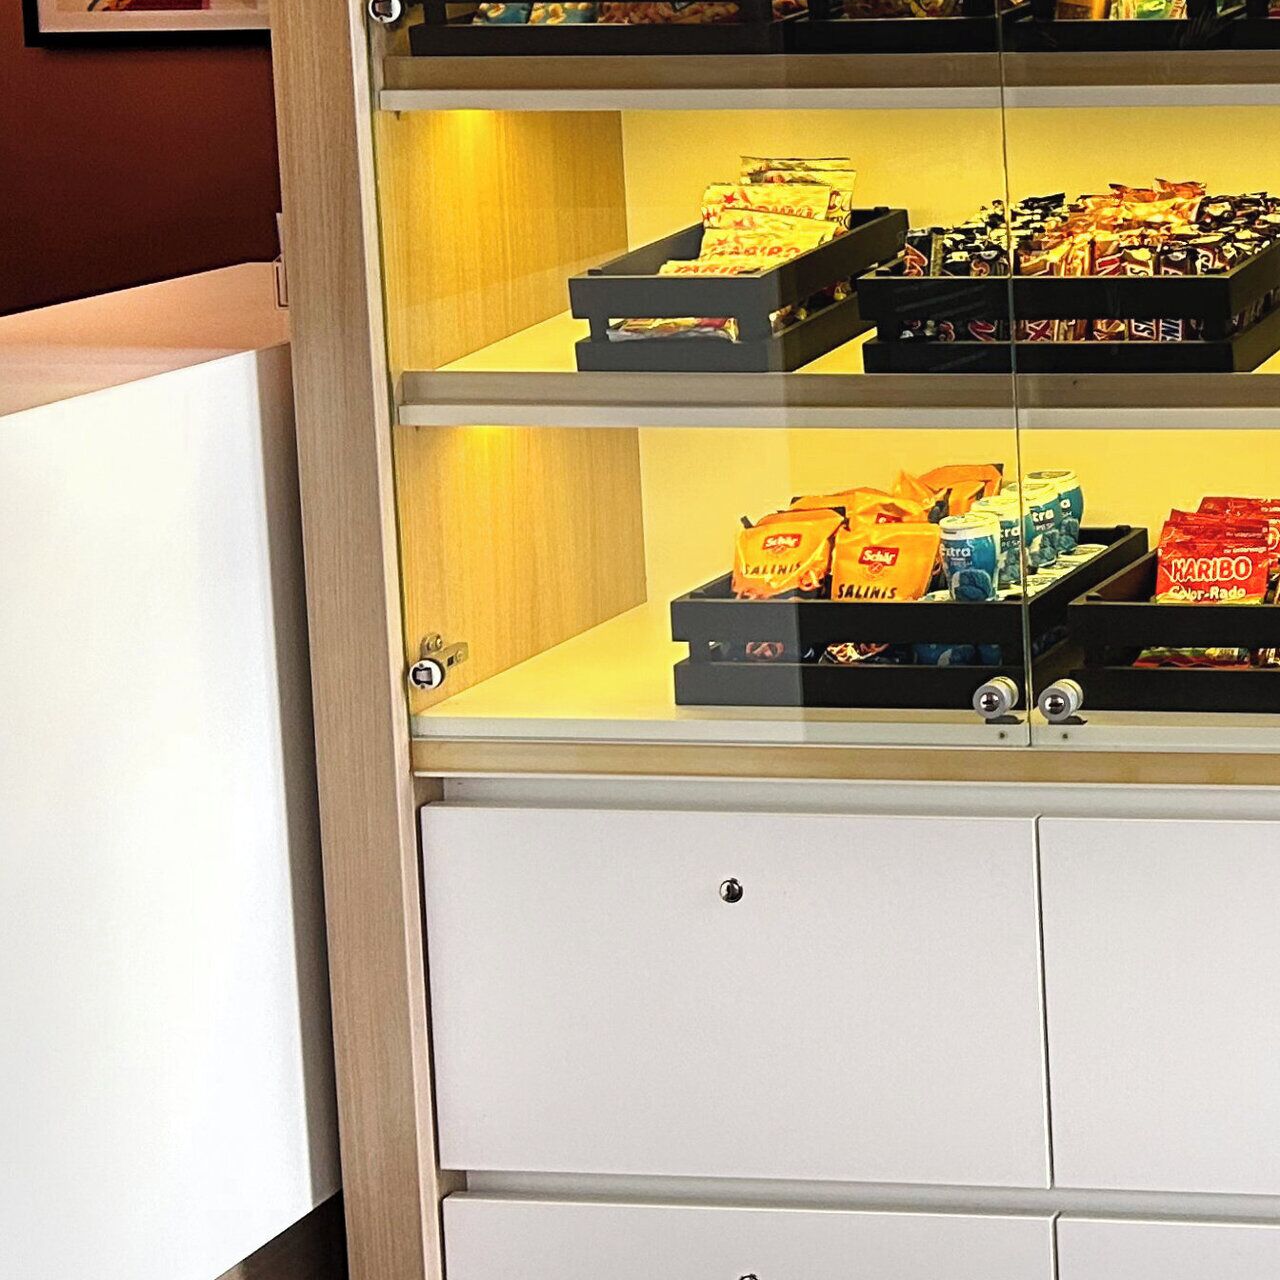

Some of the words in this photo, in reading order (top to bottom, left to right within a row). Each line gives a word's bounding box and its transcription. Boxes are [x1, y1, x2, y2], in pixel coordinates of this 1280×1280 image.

[1171, 556, 1252, 583] HARIBO
[838, 584, 898, 600] SALINIS
[1170, 586, 1247, 601] Color-Rado
